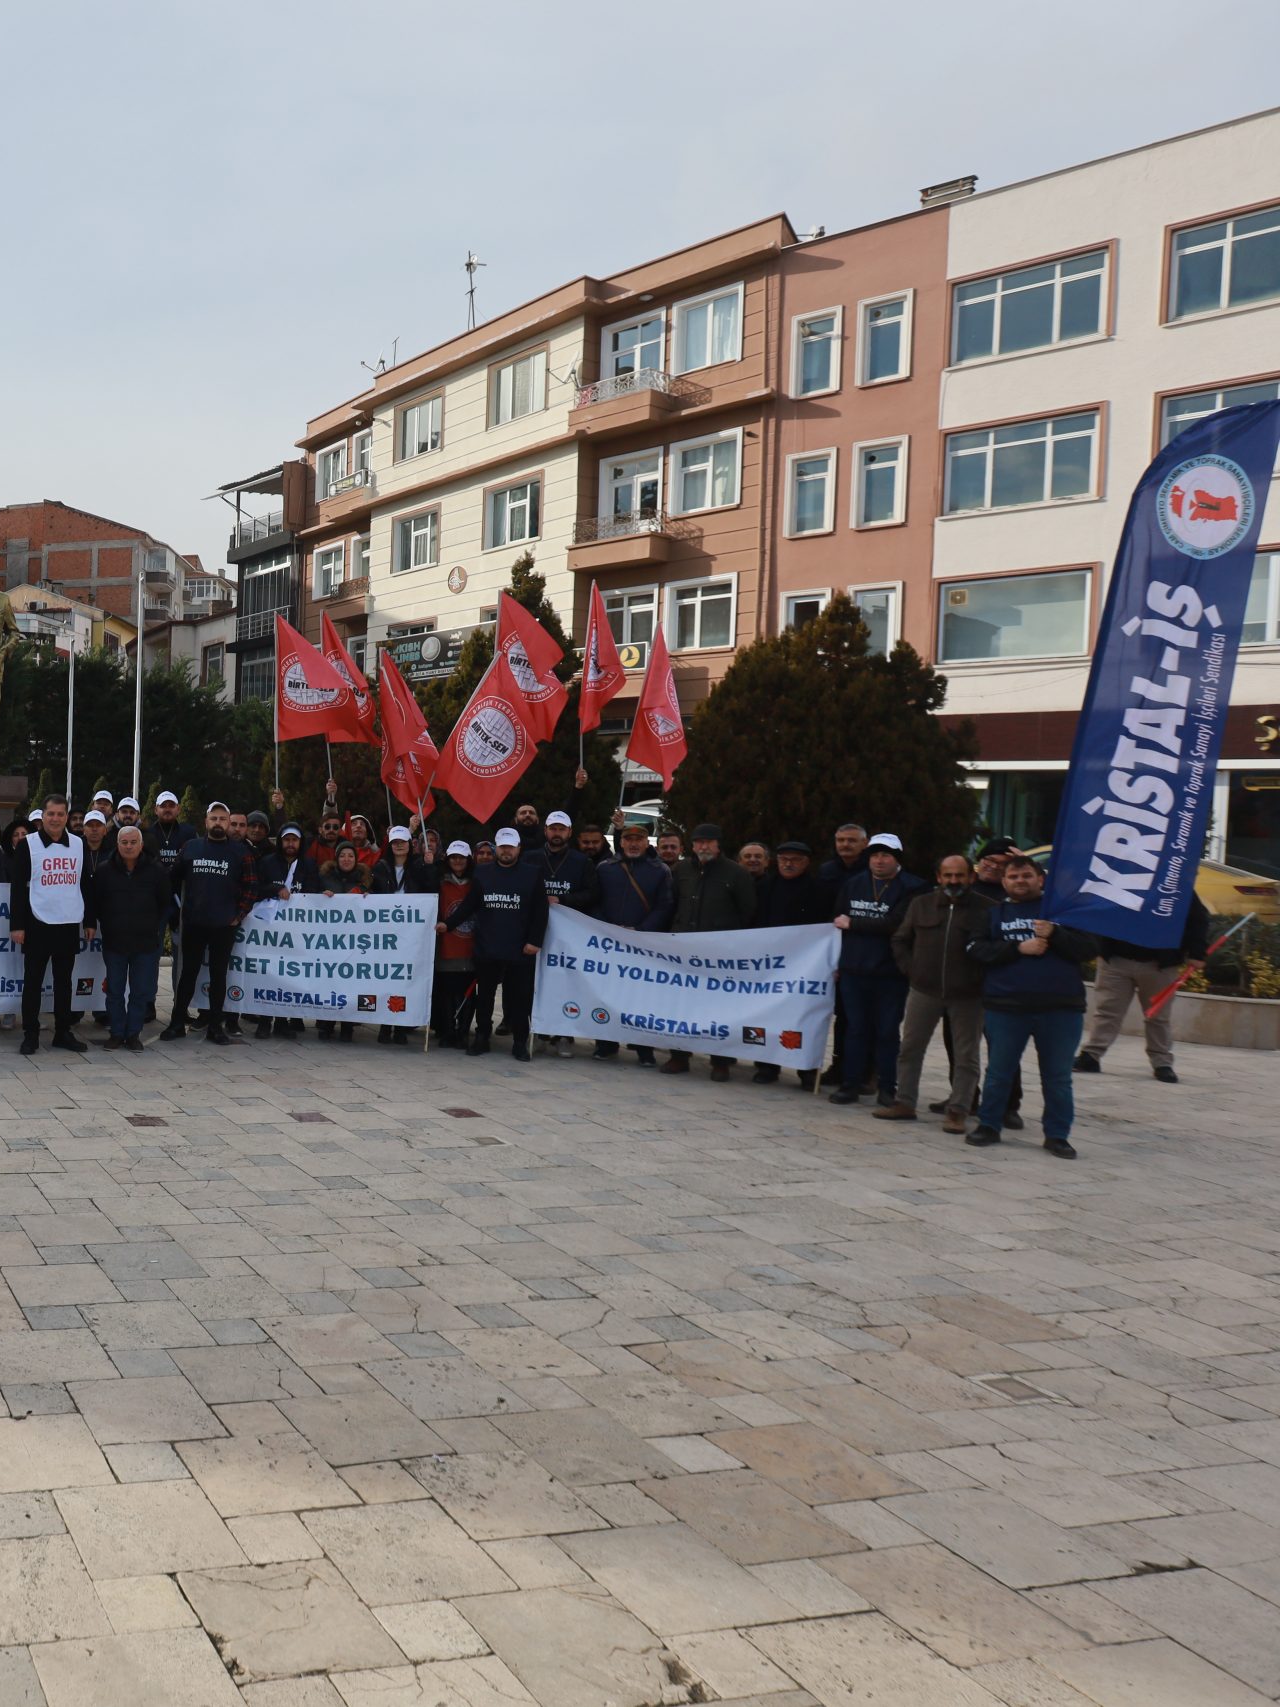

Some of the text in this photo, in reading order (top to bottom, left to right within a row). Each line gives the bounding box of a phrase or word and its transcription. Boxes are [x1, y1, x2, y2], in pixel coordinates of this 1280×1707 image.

[1078, 580, 1223, 913] KRİSTAL-İŞ
[1189, 724, 1216, 760] Sanayi
[42, 857, 77, 871] GREV
[193, 858, 229, 871] KRİSTAL-İŞ
[193, 867, 228, 876] SENDİKASI
[41, 871, 77, 886] GÖZCÜSÜ
[484, 893, 521, 905] KRİSTAL-İŞ
[274, 904, 426, 924] NIRINDA DEĞİL
[1001, 918, 1035, 930] KRİST
[234, 928, 398, 954] SANA YAKIŞIR
[587, 935, 786, 971] AÇLIKTAN ÖLMEYİZ
[229, 955, 413, 981] RET İSTİYORUZ!
[546, 952, 828, 996] BİZ BU YOLDAN DÖNMEYİZ!
[253, 987, 348, 1010] KRİSTAL-İŞ
[620, 1012, 730, 1041] KRİSTAL-İŞ
